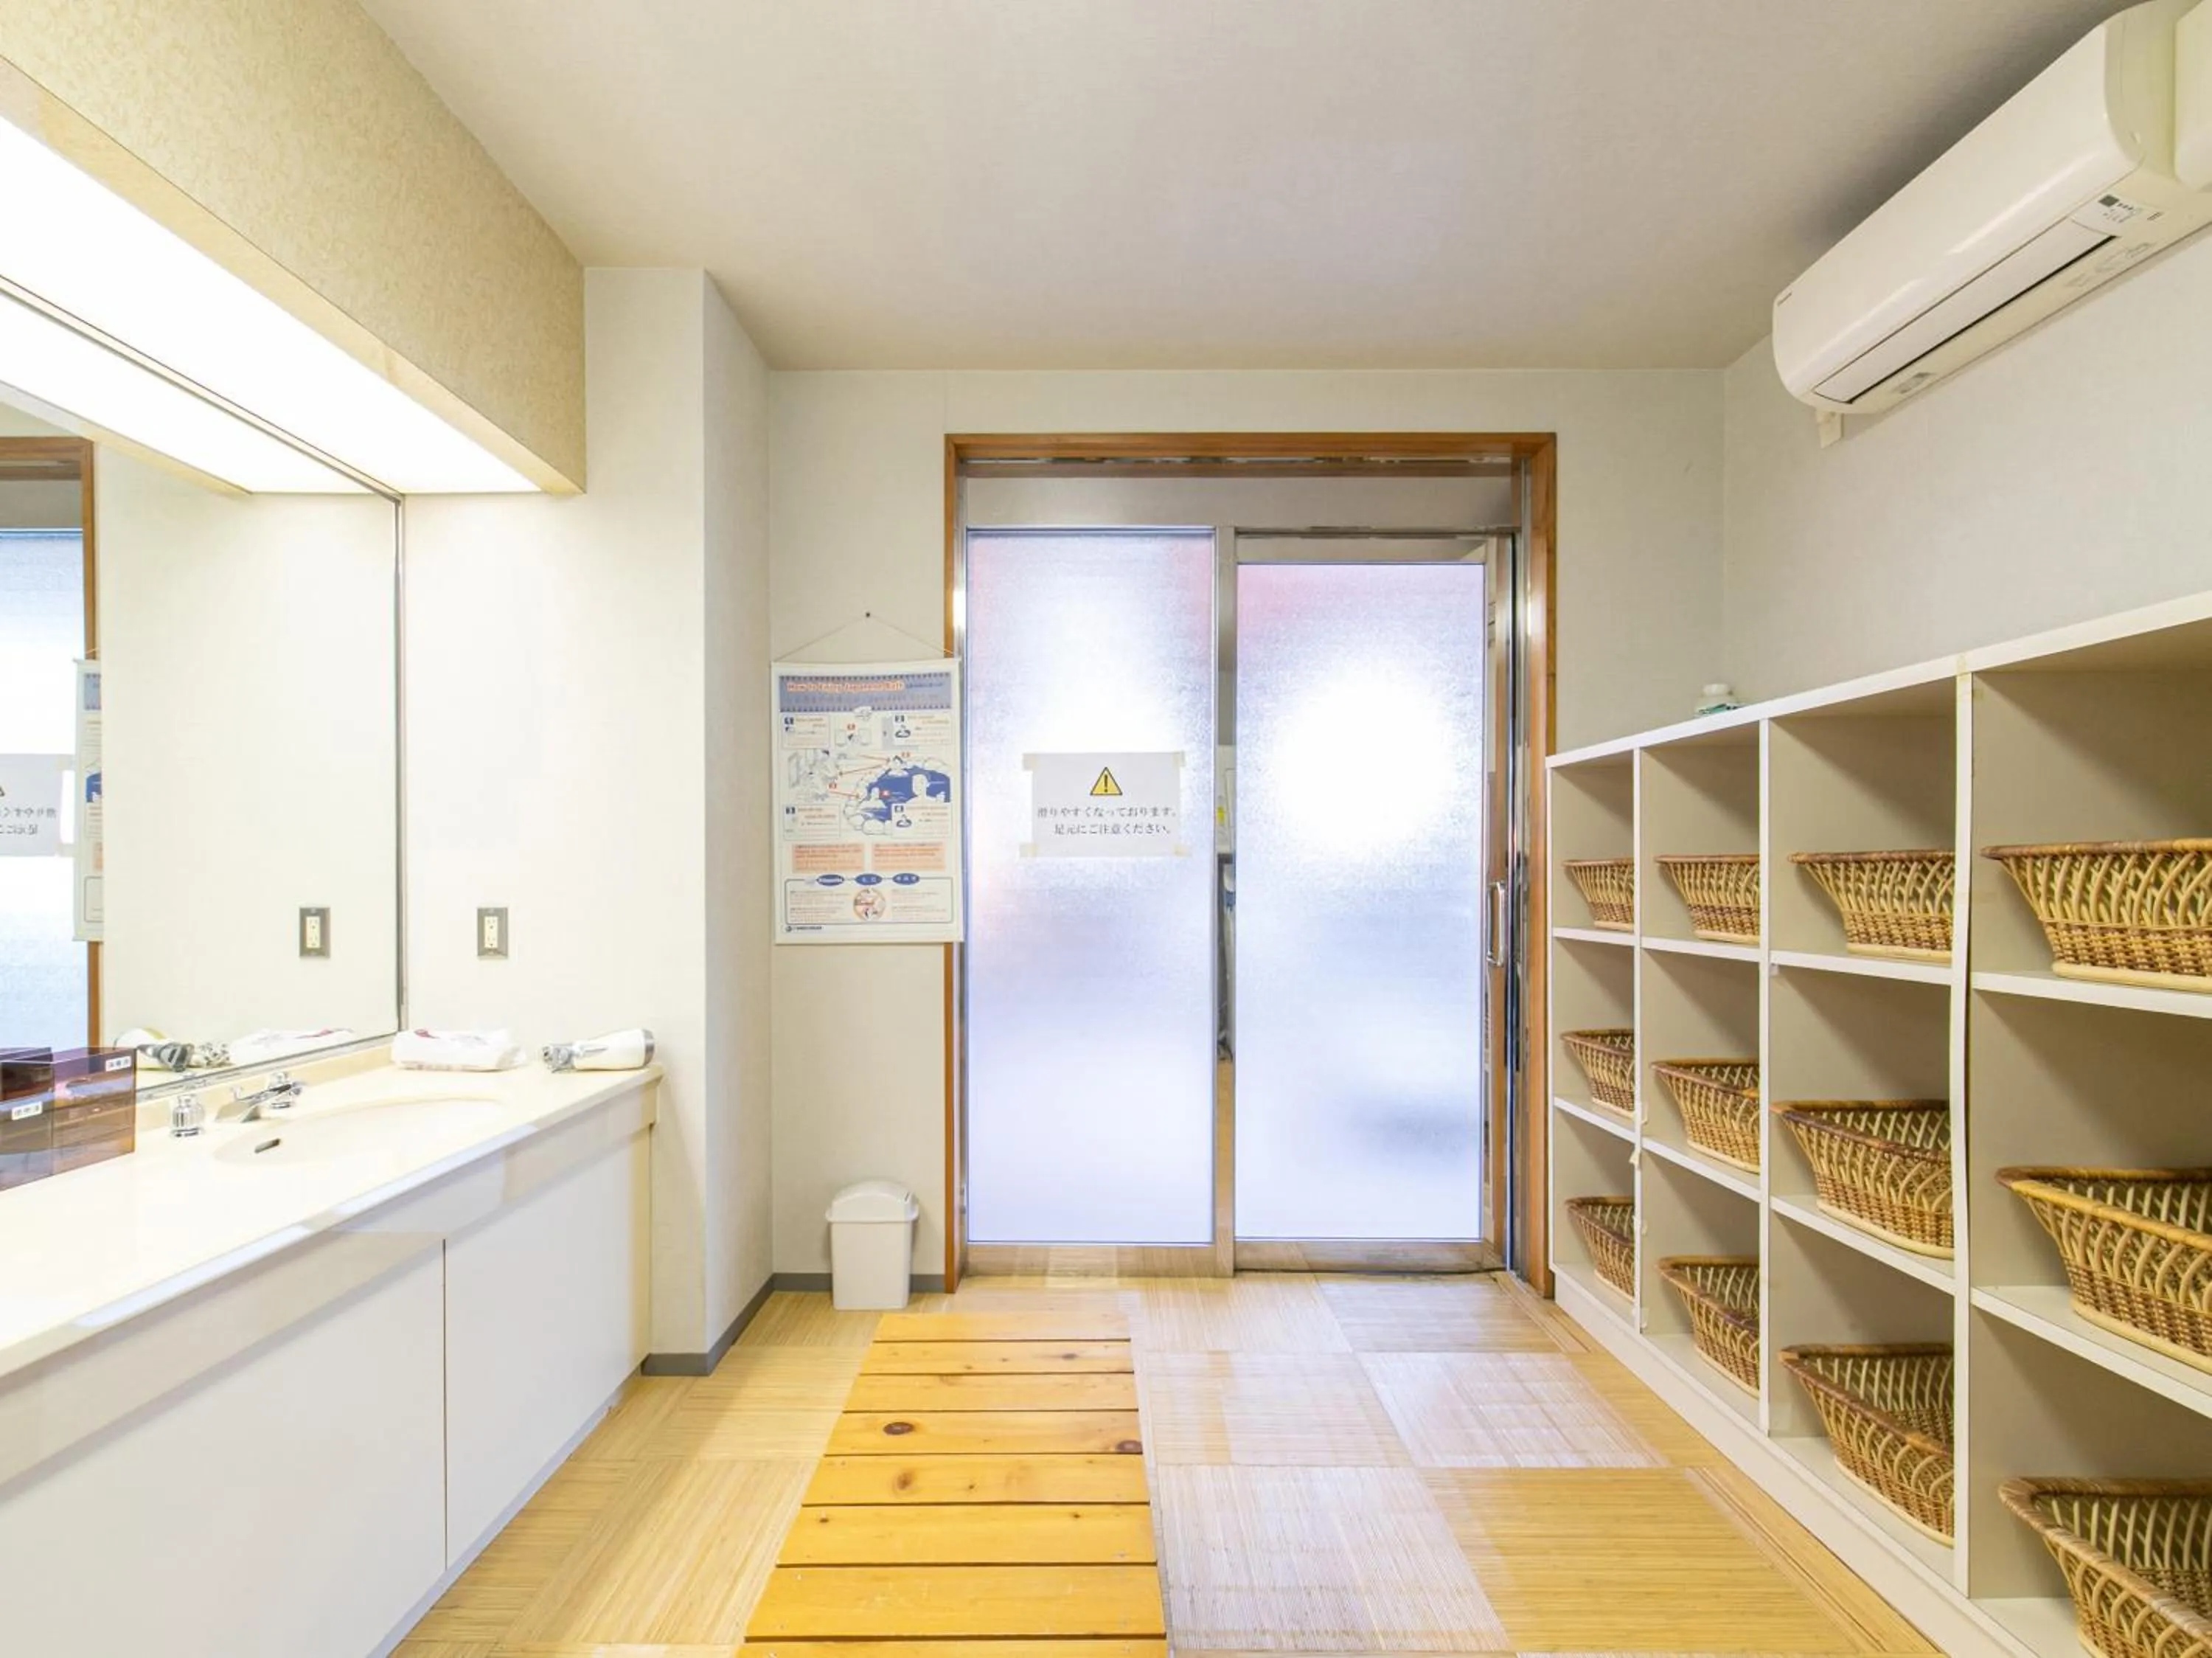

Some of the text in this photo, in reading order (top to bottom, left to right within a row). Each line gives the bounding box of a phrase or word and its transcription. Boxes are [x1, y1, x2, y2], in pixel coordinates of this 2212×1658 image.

[1037, 806, 1177, 818] 滑りやすくなっております。
[1054, 822, 1172, 836] 足元にご注意ください。
